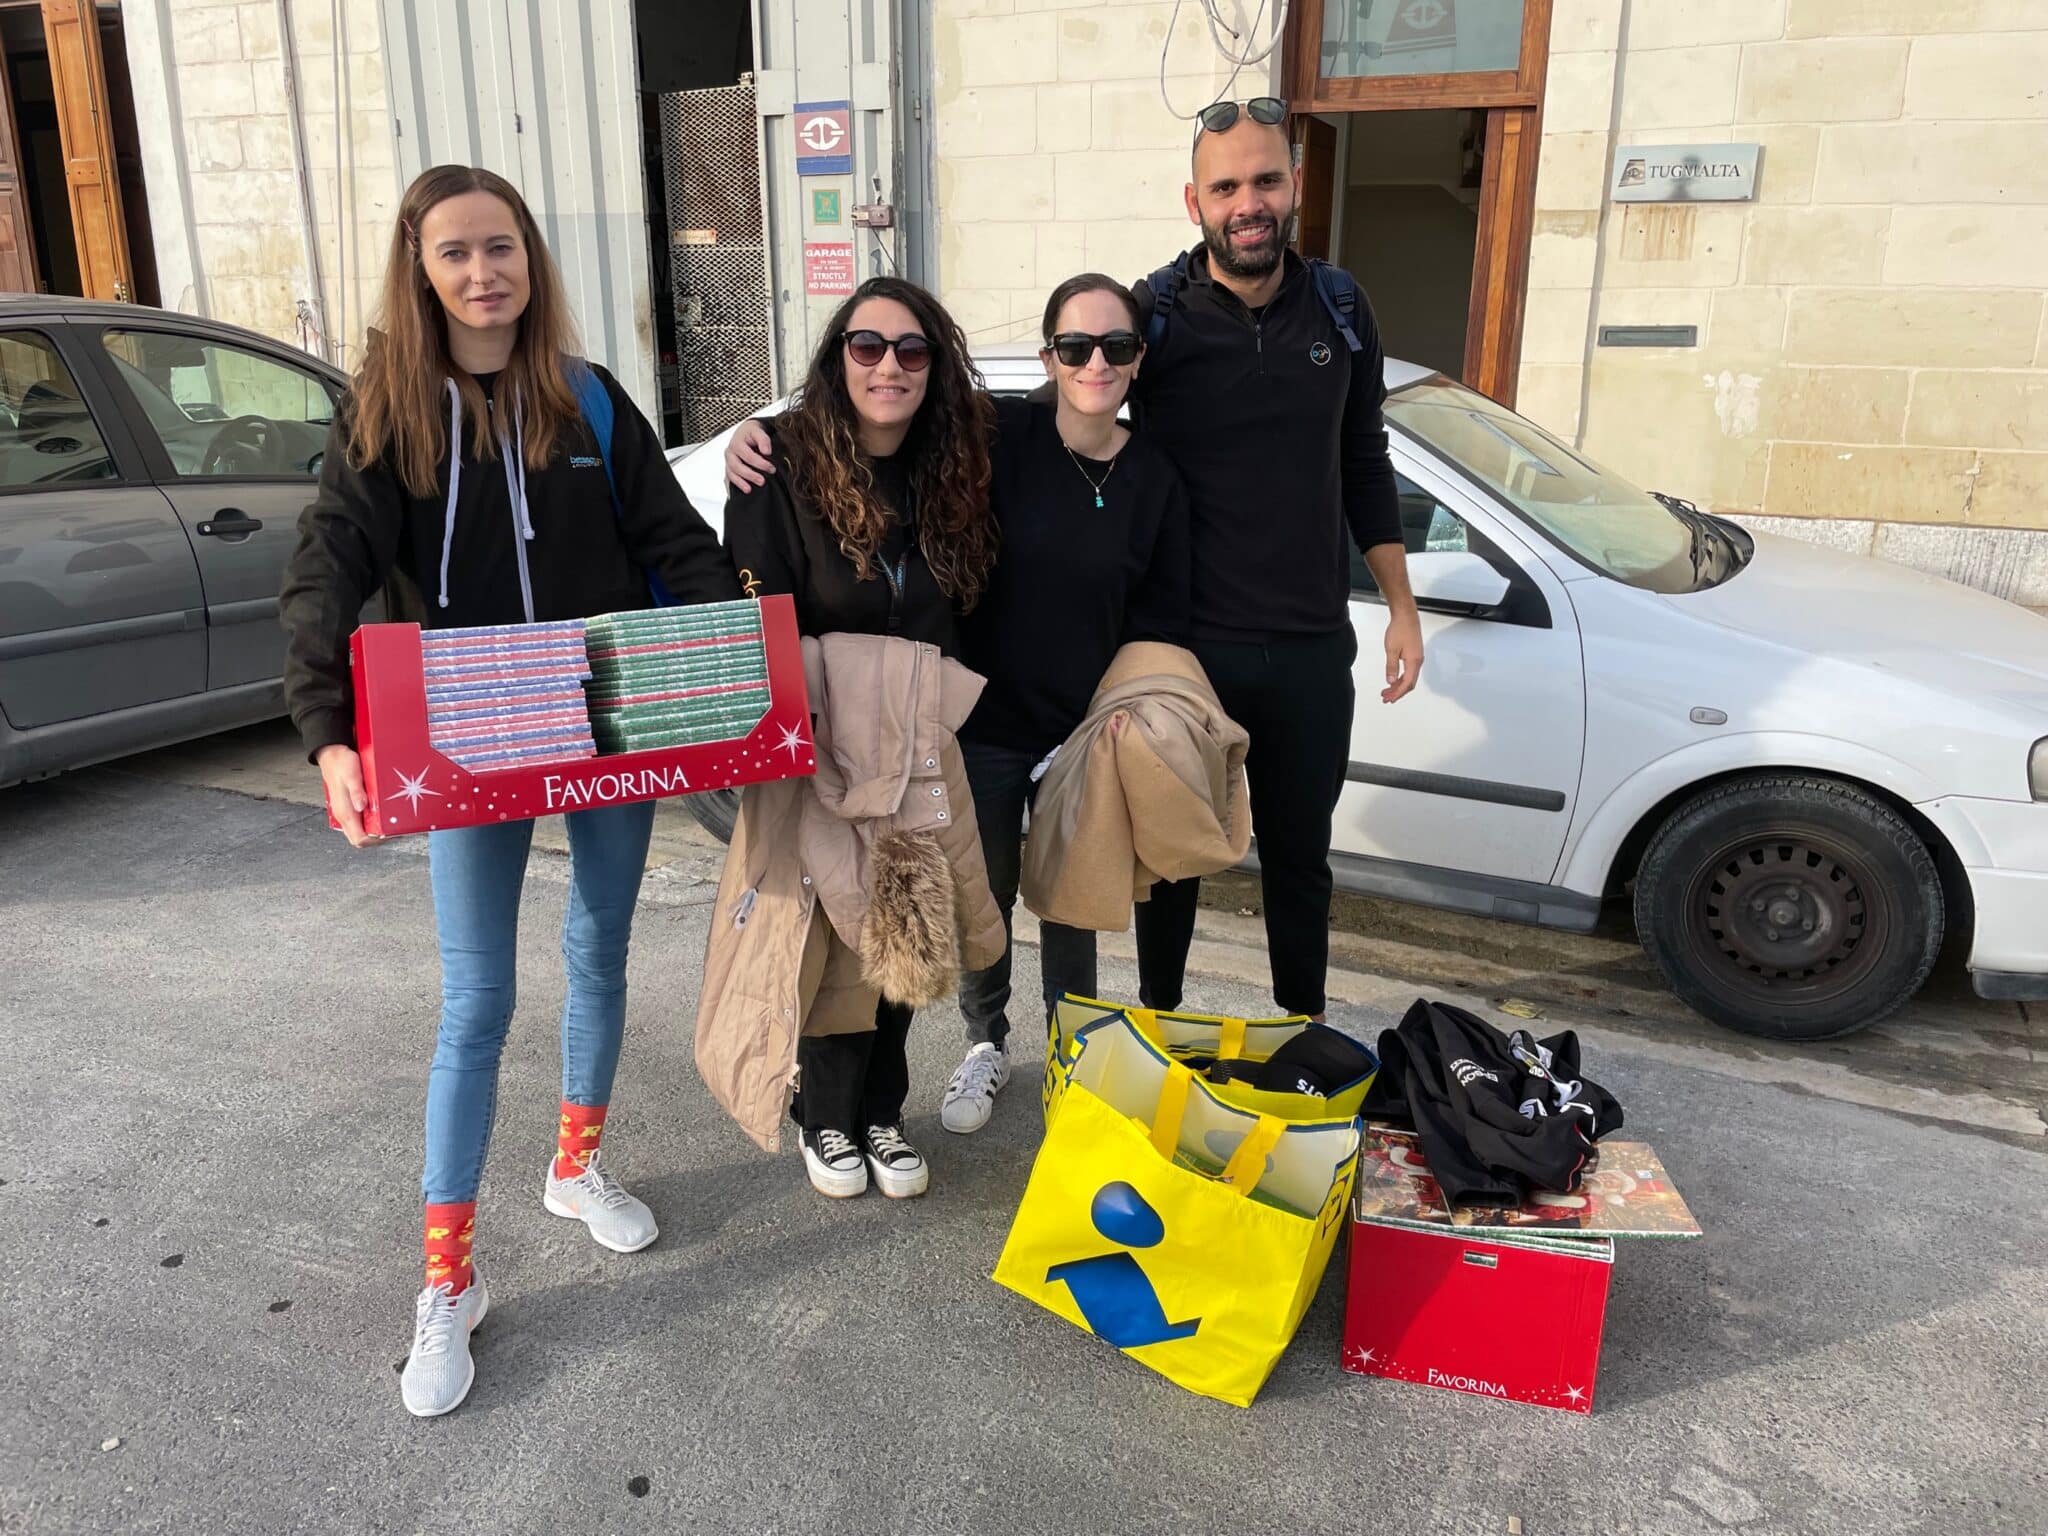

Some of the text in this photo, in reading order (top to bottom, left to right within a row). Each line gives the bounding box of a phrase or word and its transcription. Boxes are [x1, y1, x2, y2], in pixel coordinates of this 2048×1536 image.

[1649, 163, 1741, 179] TUGMALTA
[805, 248, 853, 257] GARAGE
[812, 271, 848, 281] STRICTLY
[807, 281, 853, 290] NO PARKING
[543, 764, 691, 809] FAVORINA
[1427, 1367, 1508, 1397] FAVORINA
